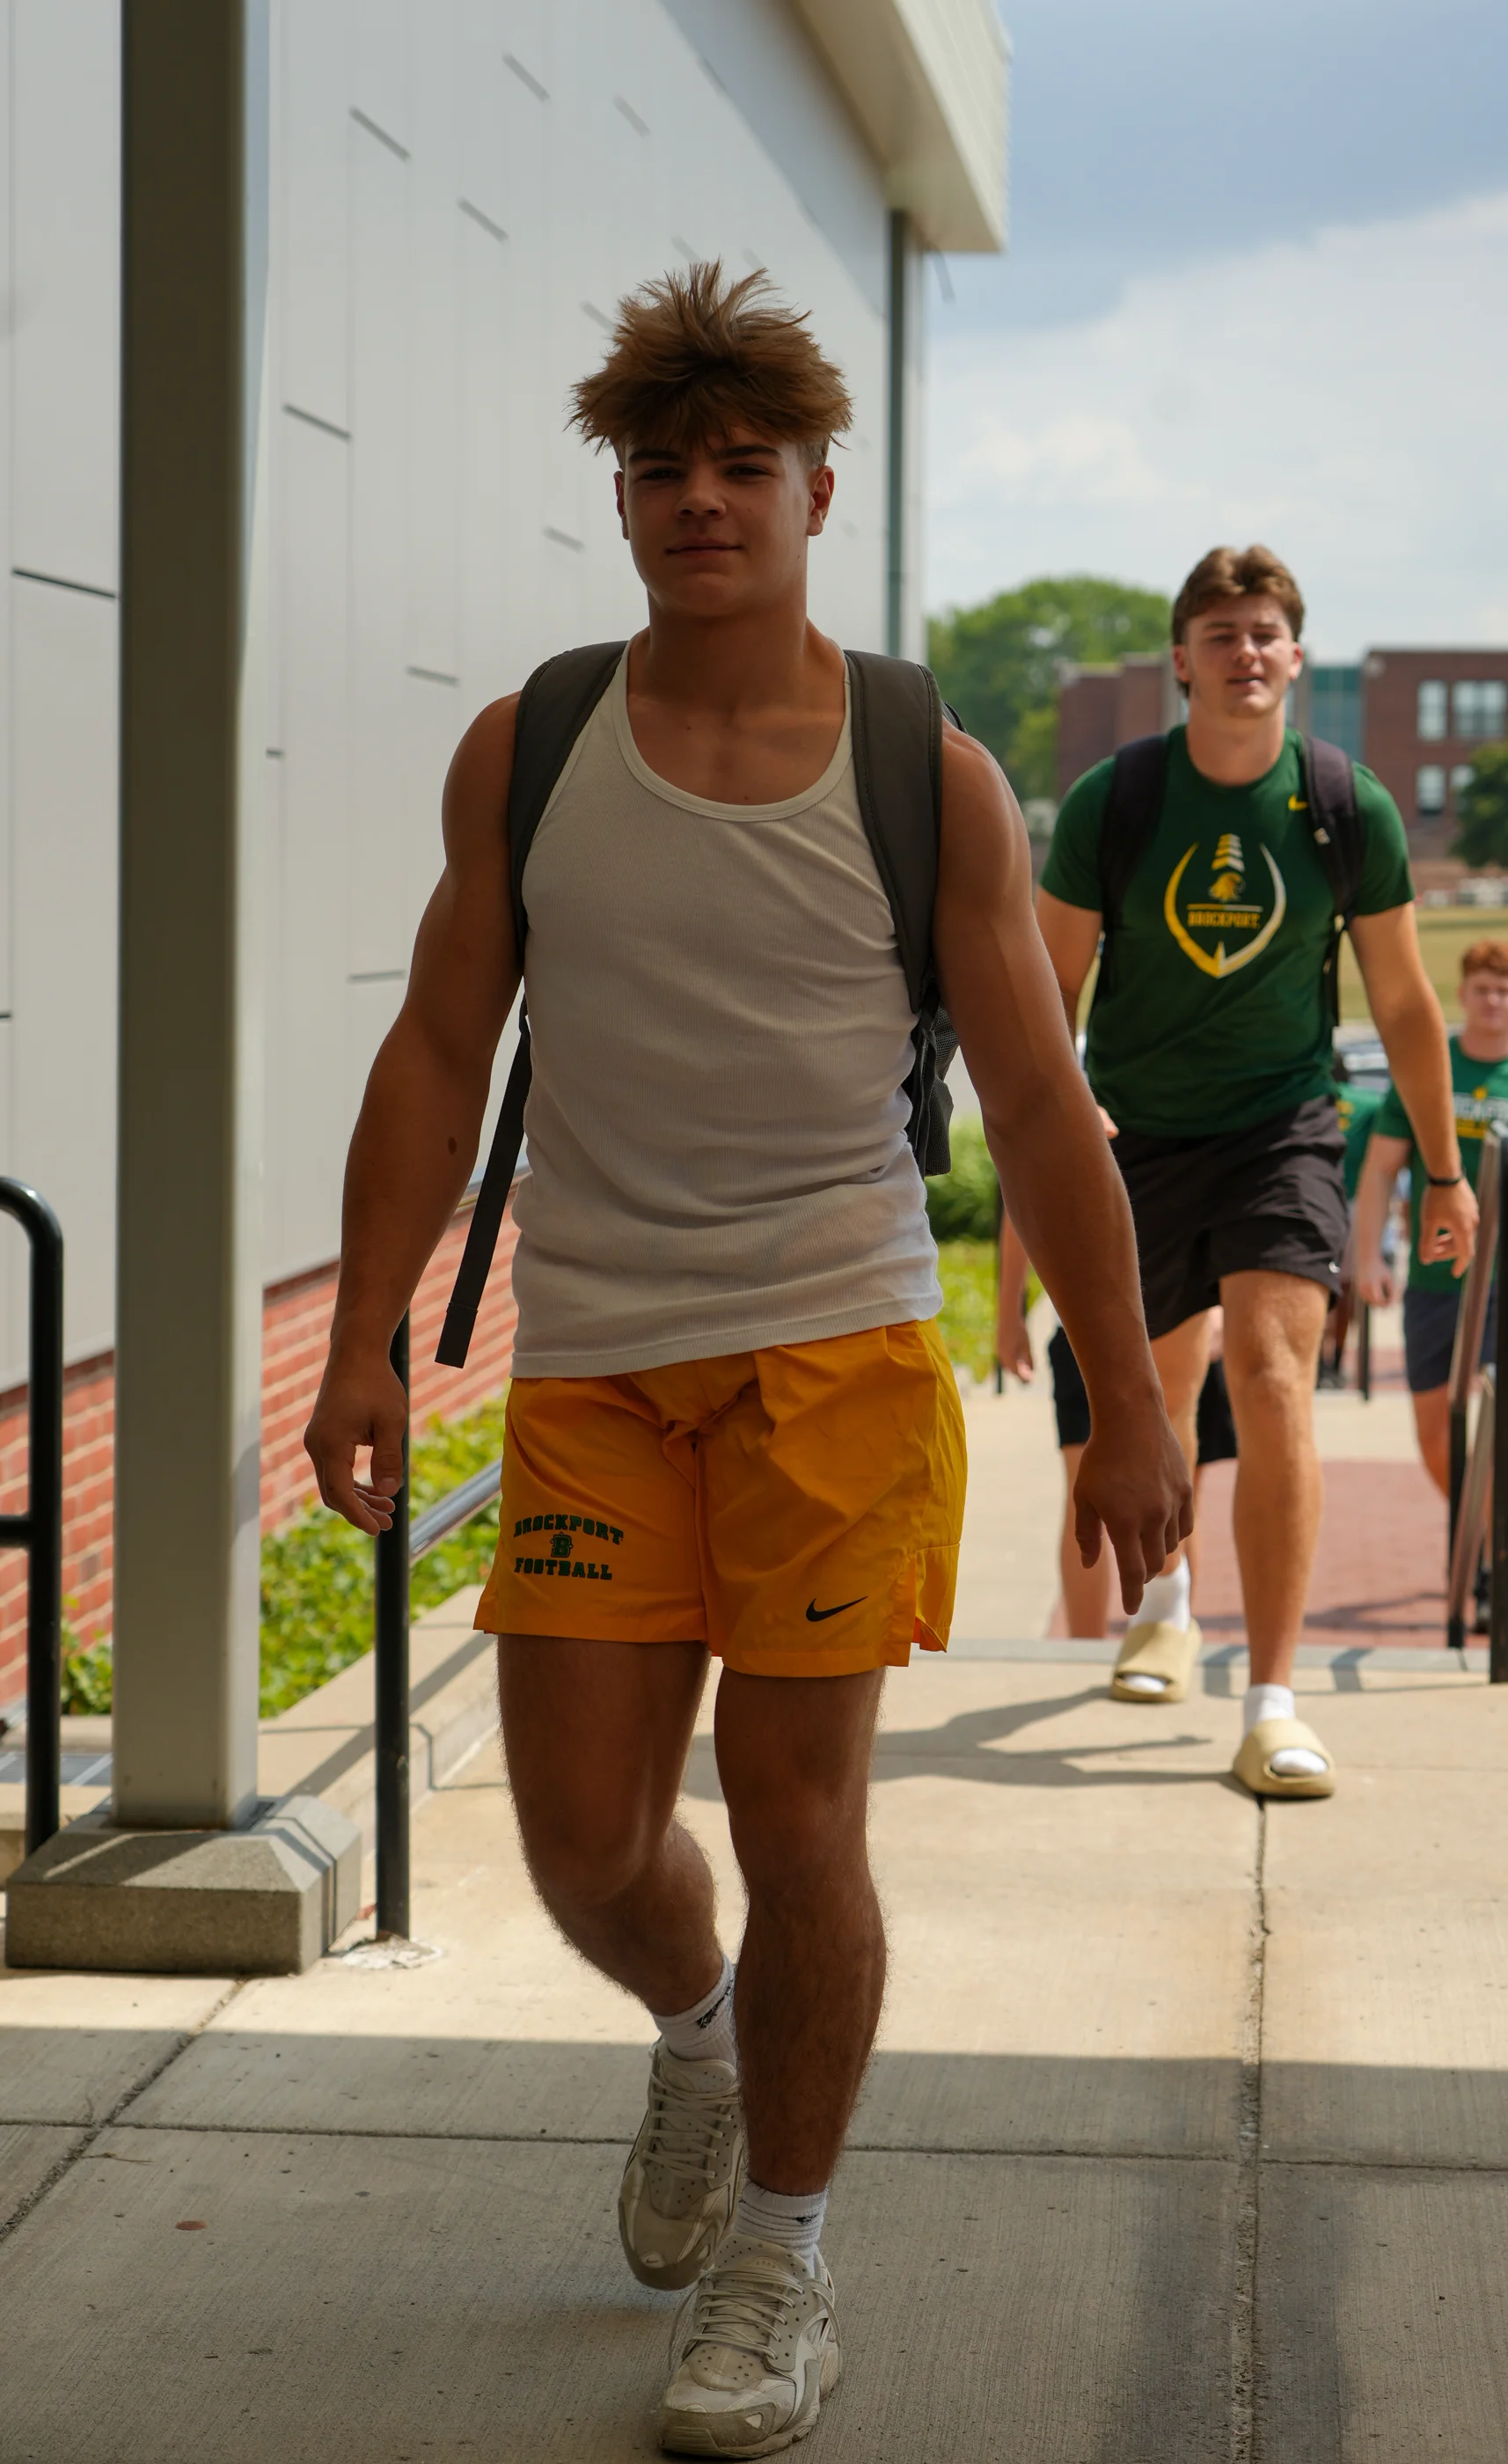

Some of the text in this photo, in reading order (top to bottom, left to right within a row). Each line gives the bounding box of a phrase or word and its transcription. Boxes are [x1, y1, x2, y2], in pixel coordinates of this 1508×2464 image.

[514, 1514, 624, 1545] BROCKPORT
[551, 1533, 573, 1558] B
[514, 1558, 612, 1580] FOOTBALL
